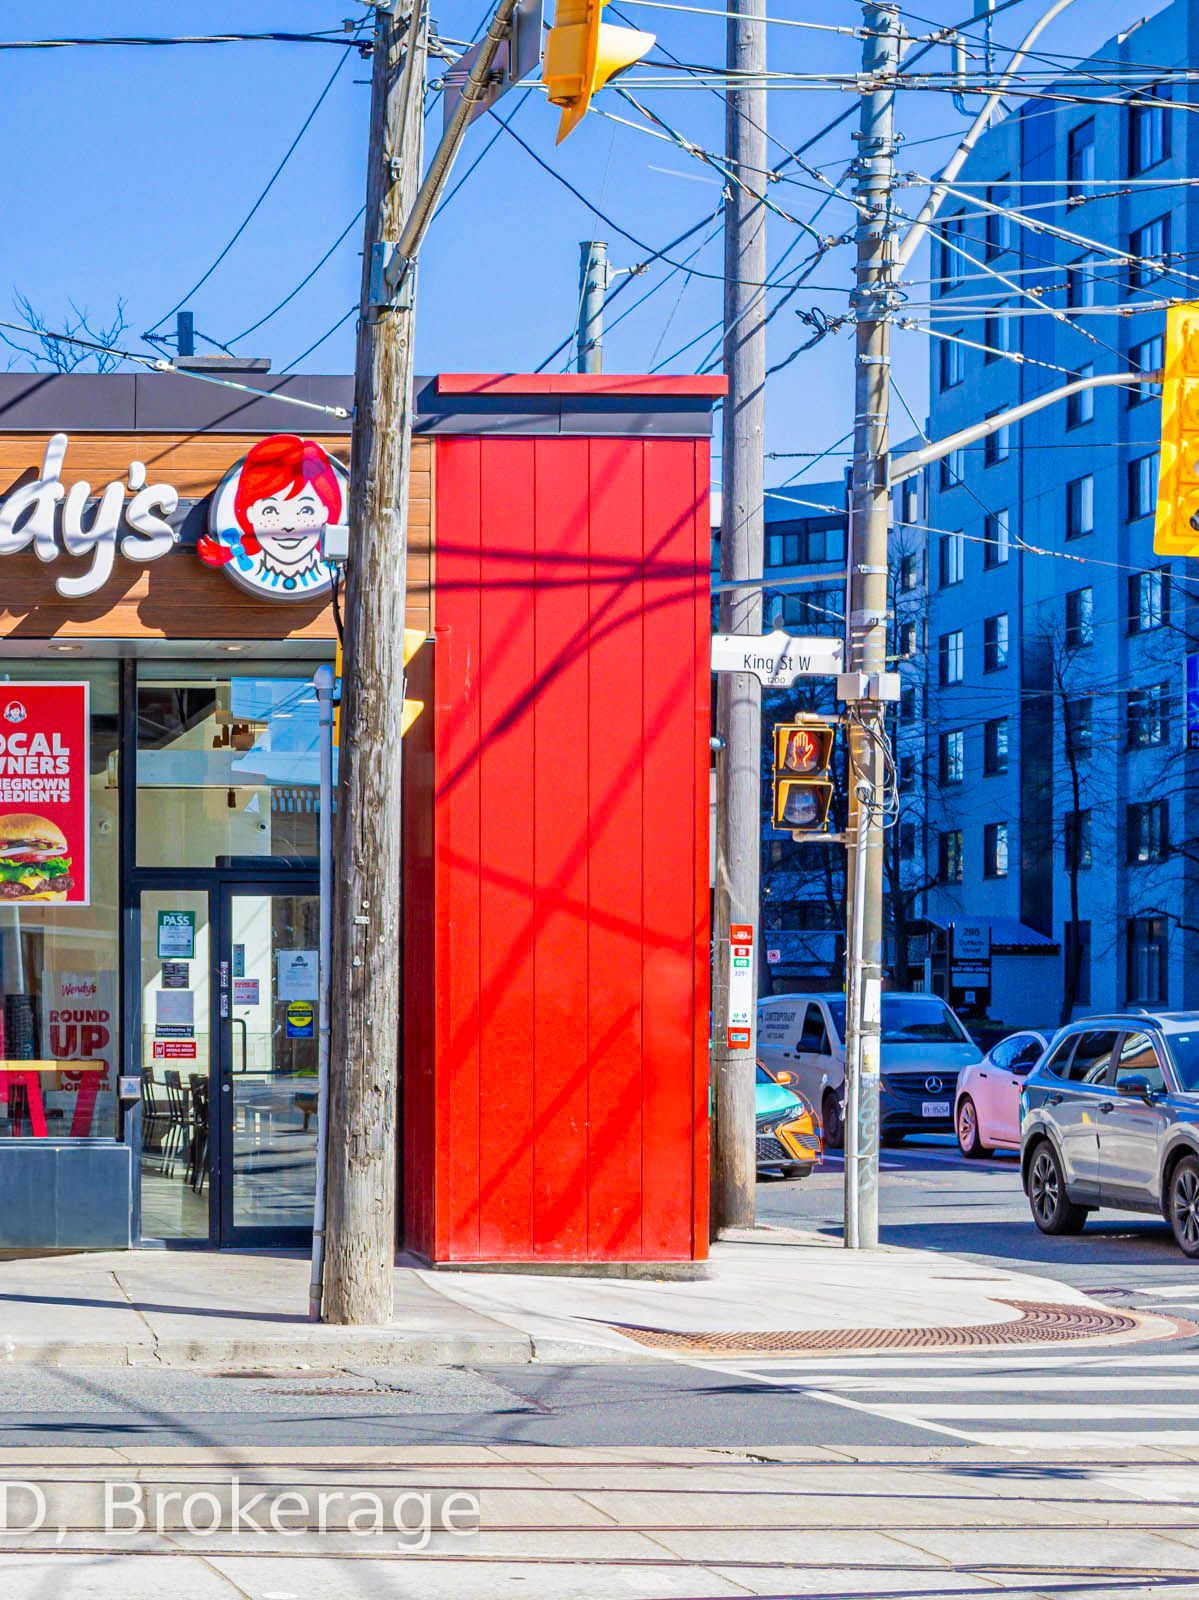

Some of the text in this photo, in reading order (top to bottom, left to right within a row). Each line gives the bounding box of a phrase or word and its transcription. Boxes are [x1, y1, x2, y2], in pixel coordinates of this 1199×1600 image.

[744, 654, 811, 672] King St W
[163, 915, 190, 926] PASS
[61, 982, 97, 996] Wendy's
[49, 1010, 110, 1022] ROUND
[50, 1024, 110, 1057] UP
